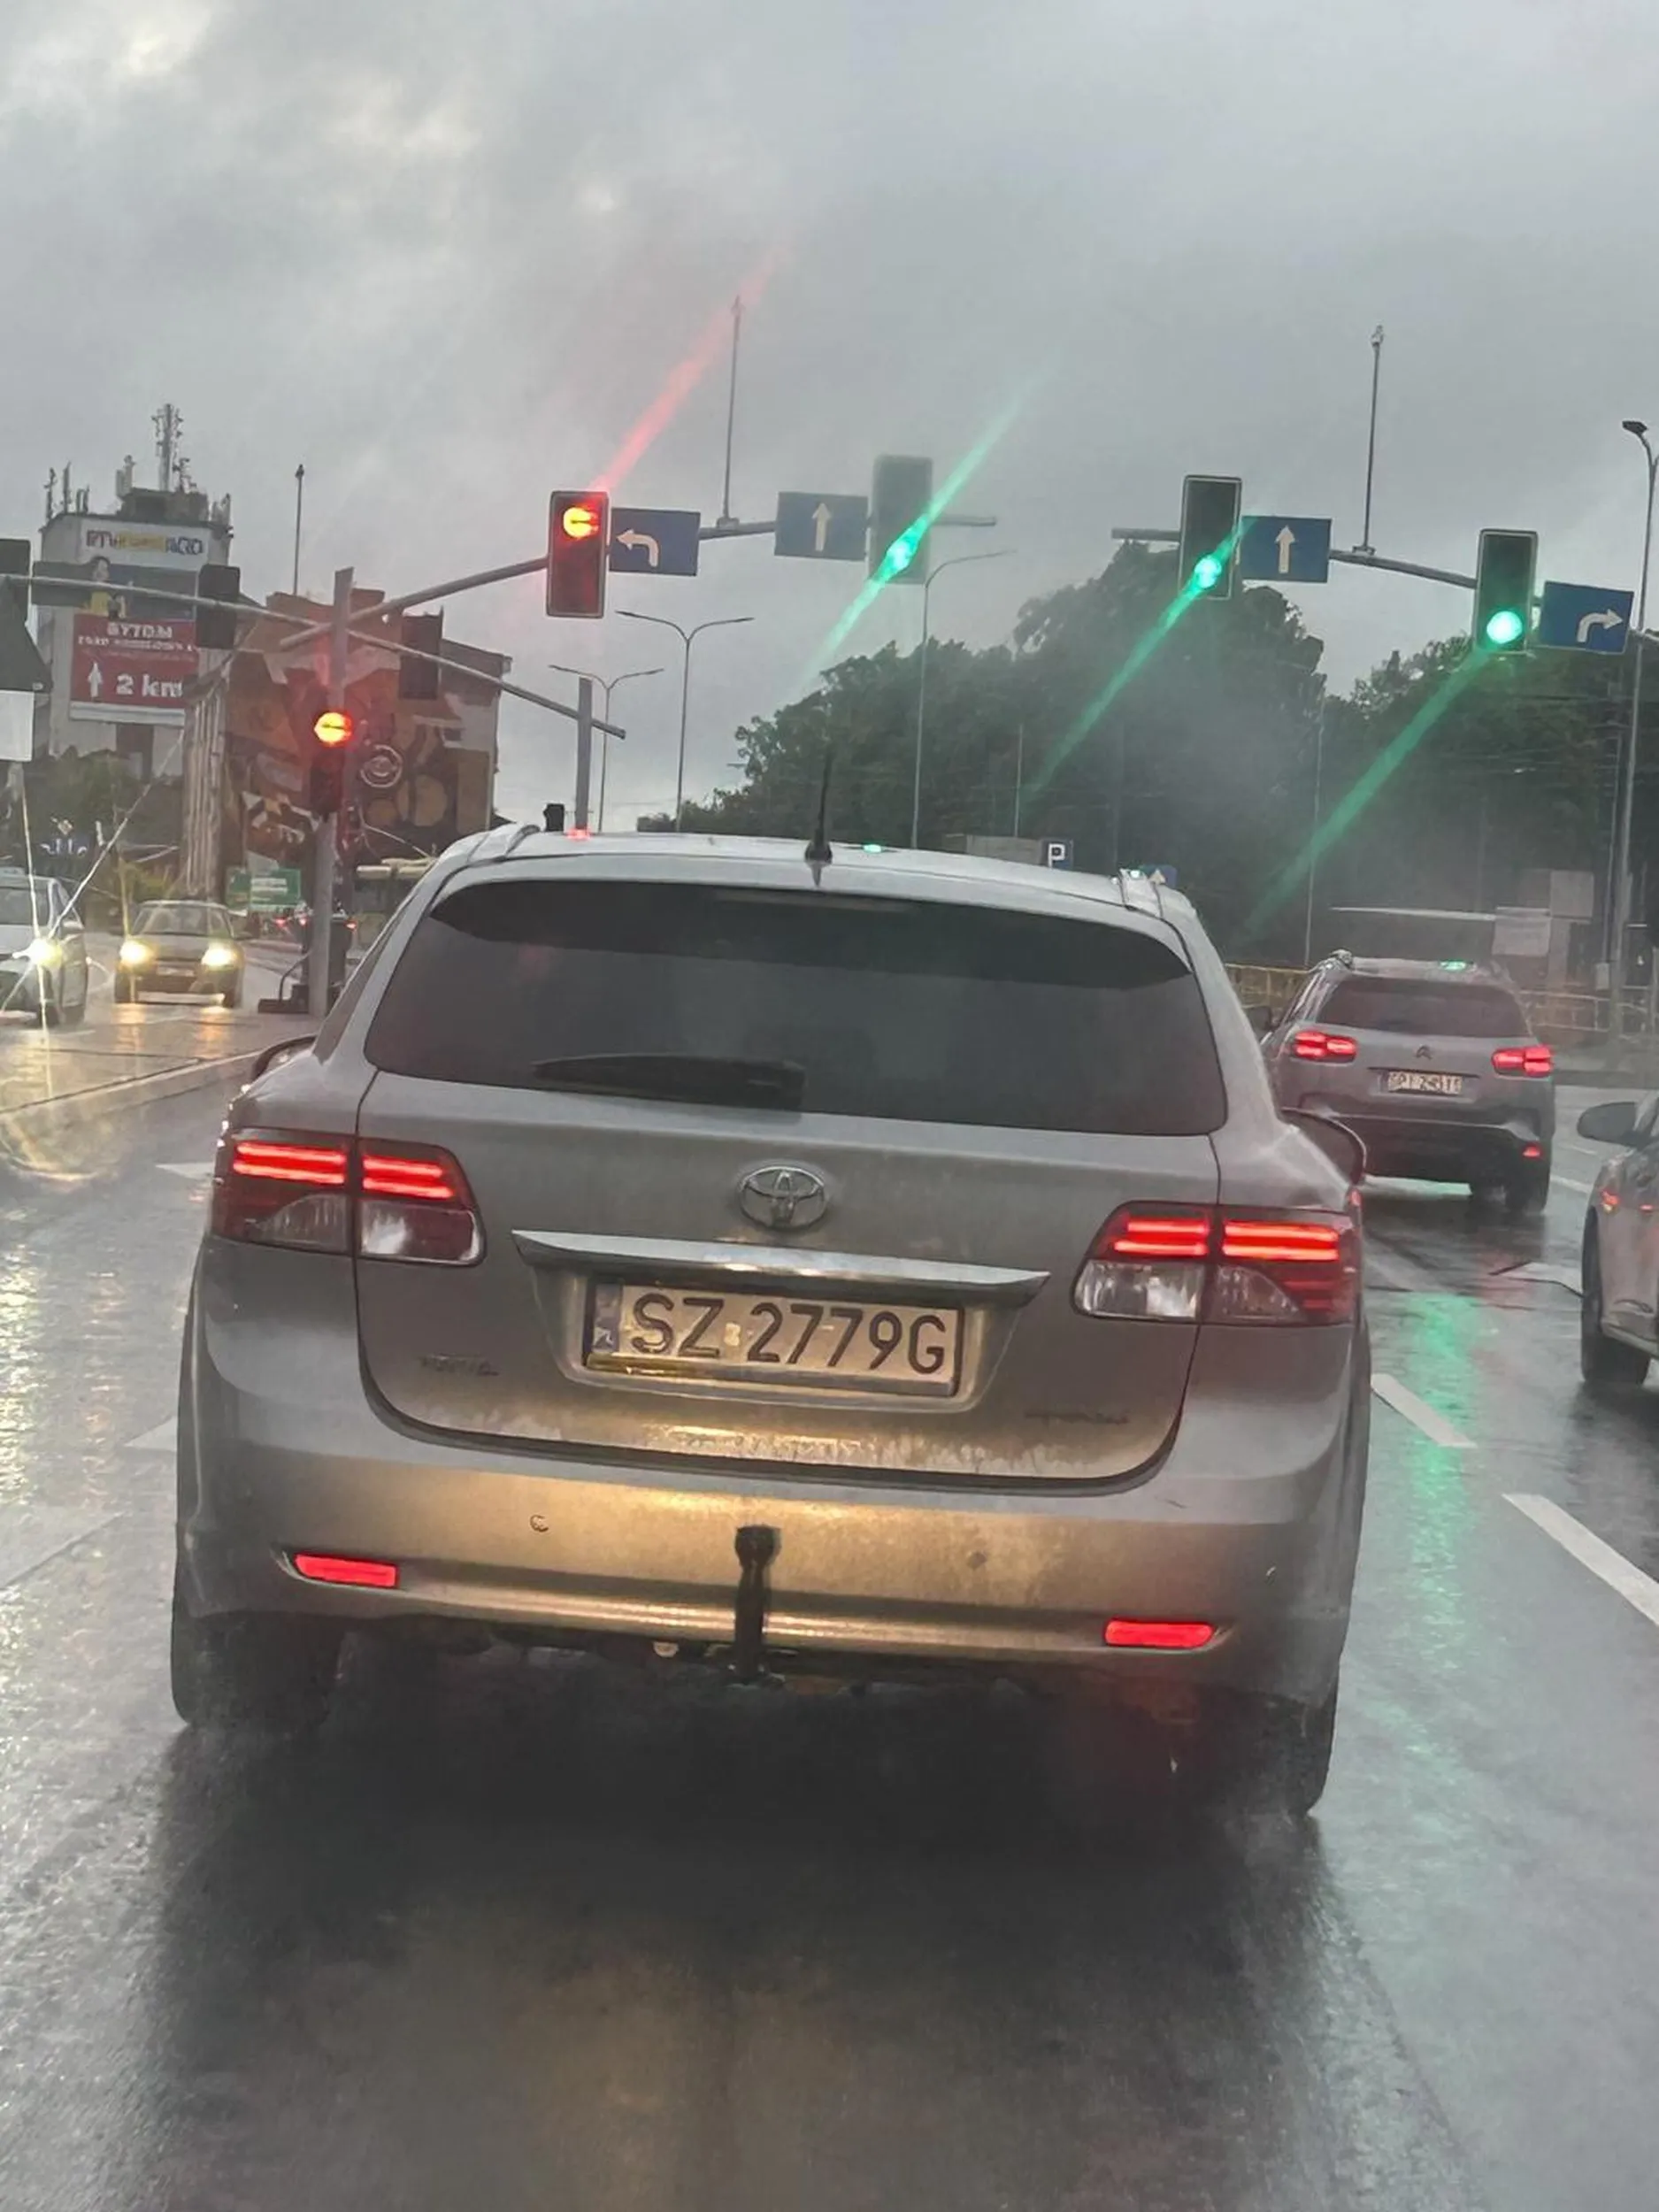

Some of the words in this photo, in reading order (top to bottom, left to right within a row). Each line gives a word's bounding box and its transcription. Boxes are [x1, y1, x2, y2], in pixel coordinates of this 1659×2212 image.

[116, 673, 134, 695] 2
[142, 673, 183, 698] km
[1048, 843, 1065, 868] P
[631, 1293, 725, 1357] SZ
[747, 1302, 947, 1375] 2779G
